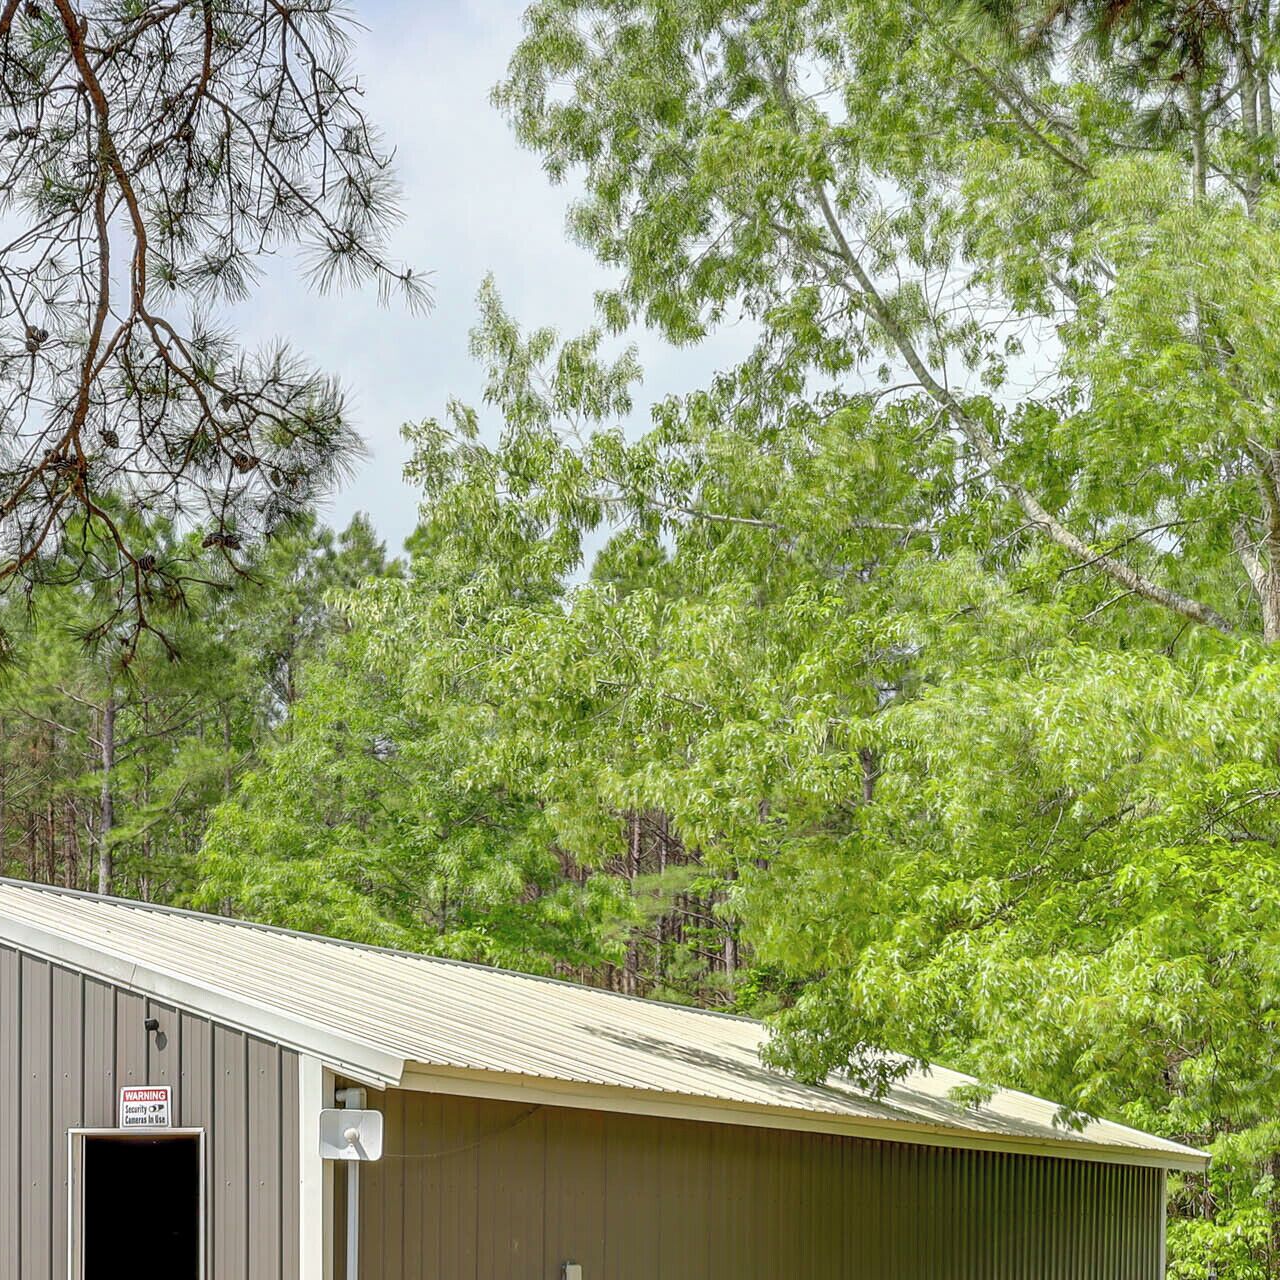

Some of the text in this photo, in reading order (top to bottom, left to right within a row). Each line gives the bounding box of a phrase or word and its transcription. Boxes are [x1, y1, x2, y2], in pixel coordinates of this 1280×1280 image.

[125, 1091, 166, 1100] WARNING
[125, 1105, 147, 1115] Security
[125, 1116, 147, 1124] Cameras
[155, 1115, 165, 1123] Use
